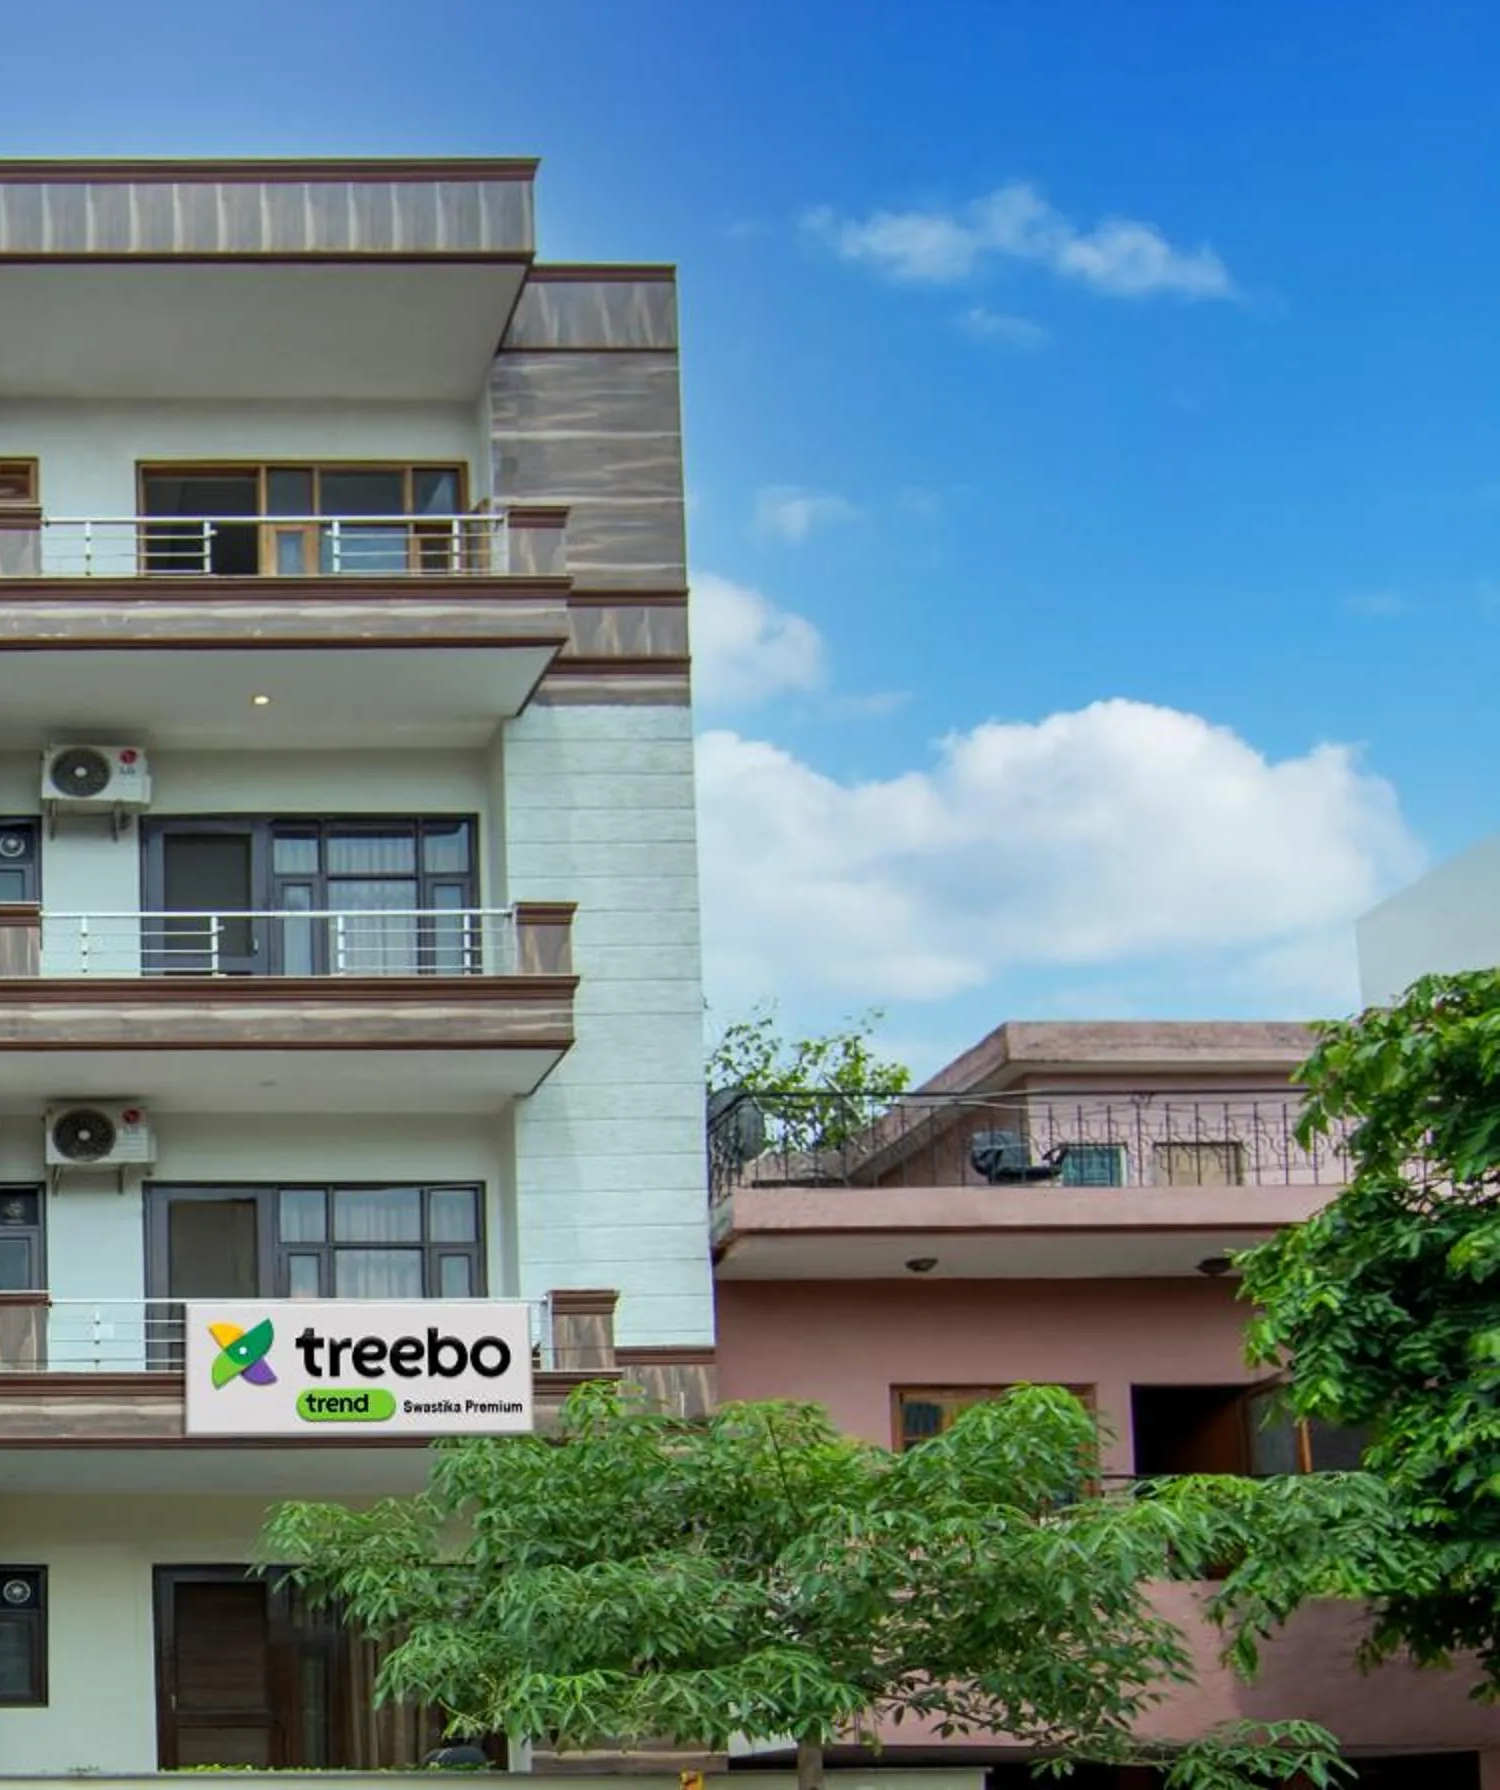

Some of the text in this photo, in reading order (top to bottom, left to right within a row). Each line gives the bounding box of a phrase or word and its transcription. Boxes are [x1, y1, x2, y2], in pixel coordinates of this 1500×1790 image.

[295, 1327, 511, 1378] treebo
[305, 1393, 369, 1413] trend
[403, 1399, 523, 1413] Swastika Premium
